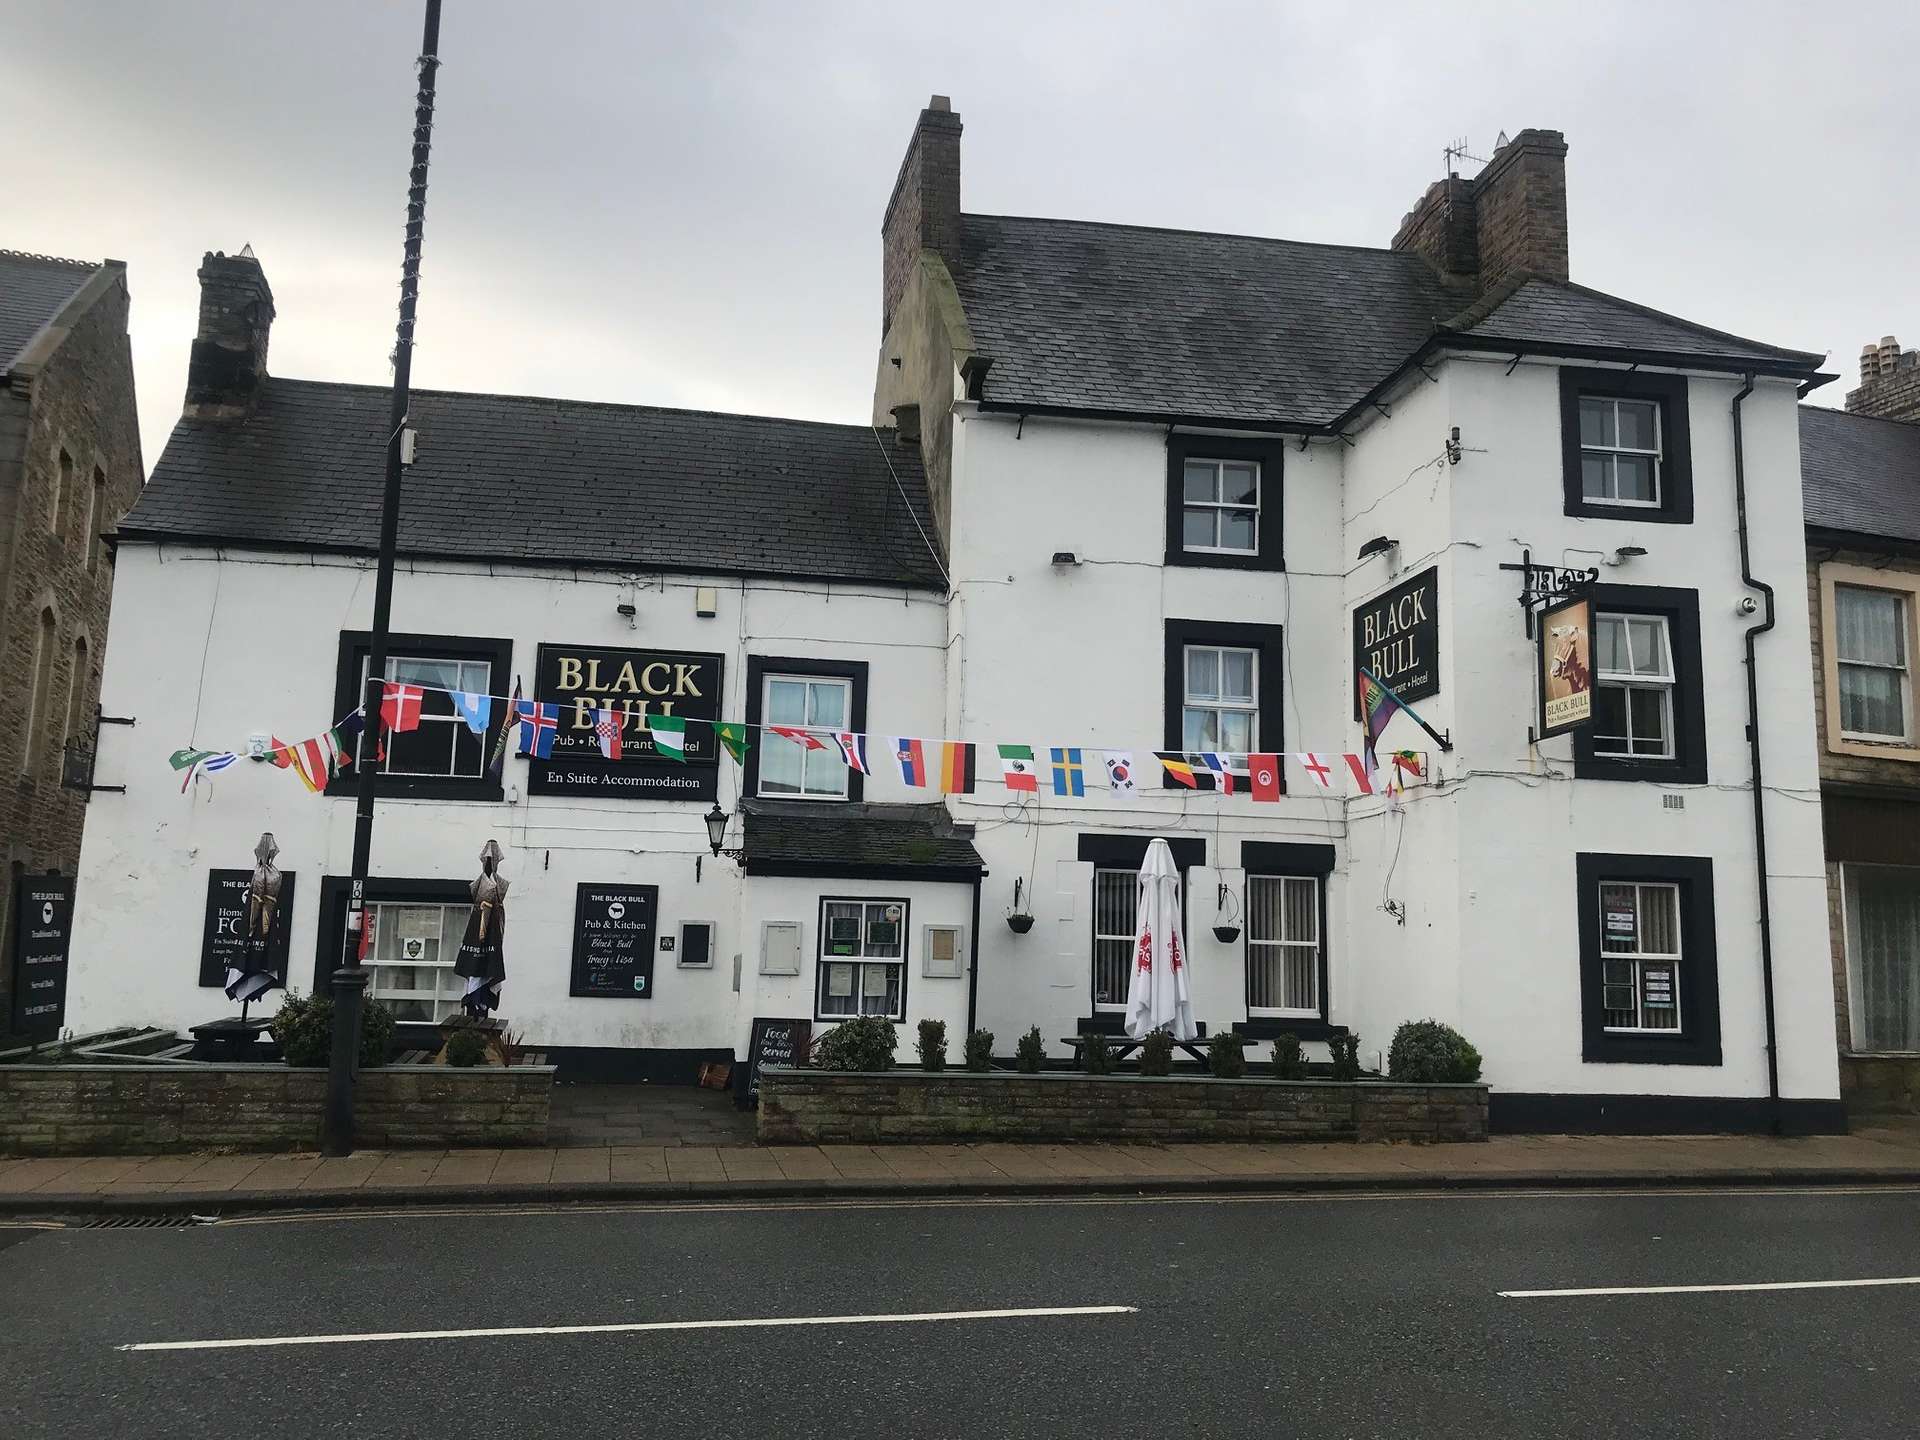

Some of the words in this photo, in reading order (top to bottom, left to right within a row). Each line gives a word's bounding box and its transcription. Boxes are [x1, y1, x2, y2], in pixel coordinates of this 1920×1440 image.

[1363, 586, 1427, 649] BLACK
[1370, 634, 1419, 681] BULL
[555, 657, 702, 697] BLACK
[1411, 671, 1428, 687] Hotel
[1547, 701, 1569, 716] BLACK
[1570, 695, 1588, 709] BULL
[552, 734, 575, 746] Pub
[547, 772, 565, 784] En
[567, 772, 599, 785] Suite
[601, 773, 701, 788] Accommodation
[585, 920, 601, 929] Pub
[603, 920, 611, 929] &
[614, 920, 646, 930] Kitchen
[765, 1027, 791, 1040] Food
[761, 1047, 792, 1058] Served
